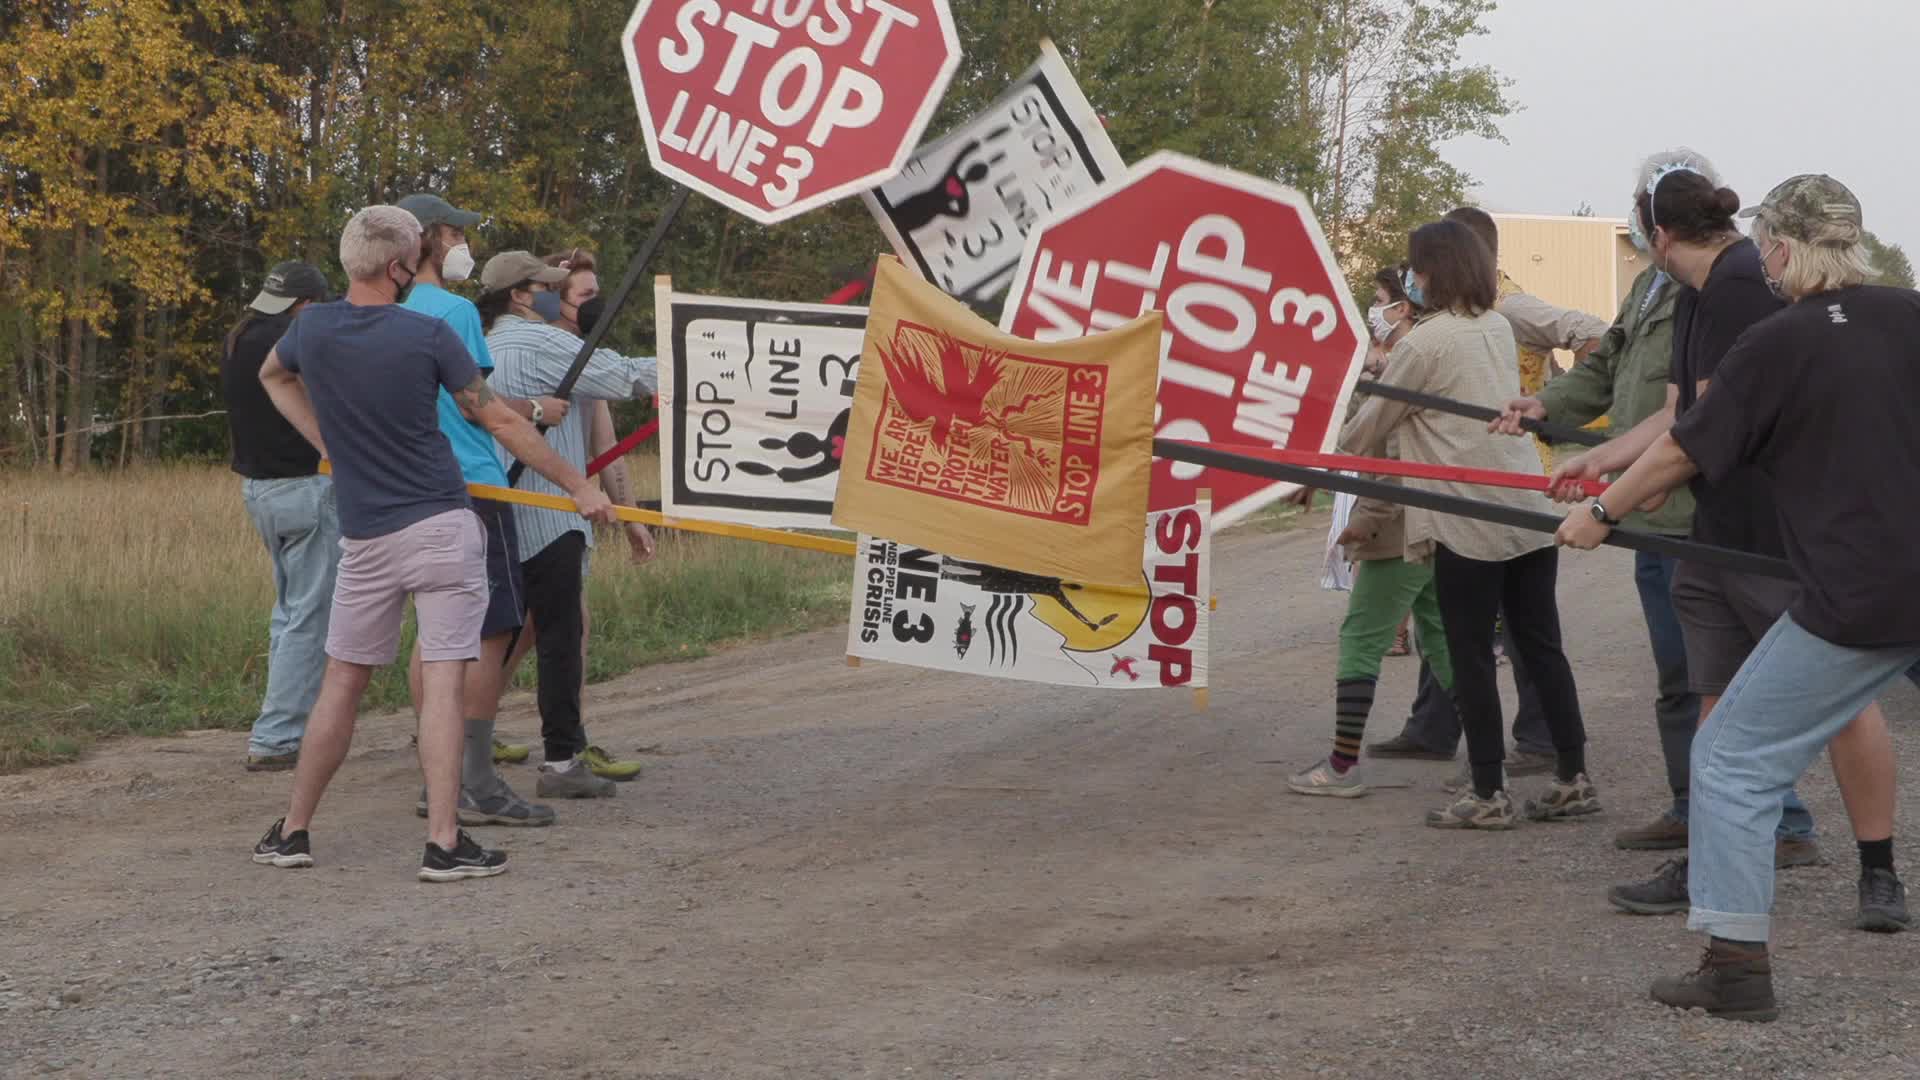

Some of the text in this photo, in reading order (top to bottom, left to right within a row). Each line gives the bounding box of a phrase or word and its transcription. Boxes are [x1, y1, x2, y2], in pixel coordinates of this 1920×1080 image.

[752, 0, 920, 67] UST
[658, 0, 885, 148] STOP
[658, 90, 815, 208] LINE 3
[962, 218, 1004, 258] 3
[765, 338, 801, 420] LINE
[1232, 287, 1337, 450] INE 3
[693, 381, 736, 482] STOP
[877, 406, 910, 478] WE ARE
[897, 431, 928, 482] HERE
[1055, 367, 1103, 518] STOP LINE 3
[916, 460, 941, 485] TO
[961, 460, 989, 495] THE
[982, 437, 1010, 501] WATER
[861, 567, 885, 644] CRISIS
[882, 567, 896, 624] PIPELINE
[892, 609, 935, 644] 3
[1147, 508, 1202, 688] STOP
